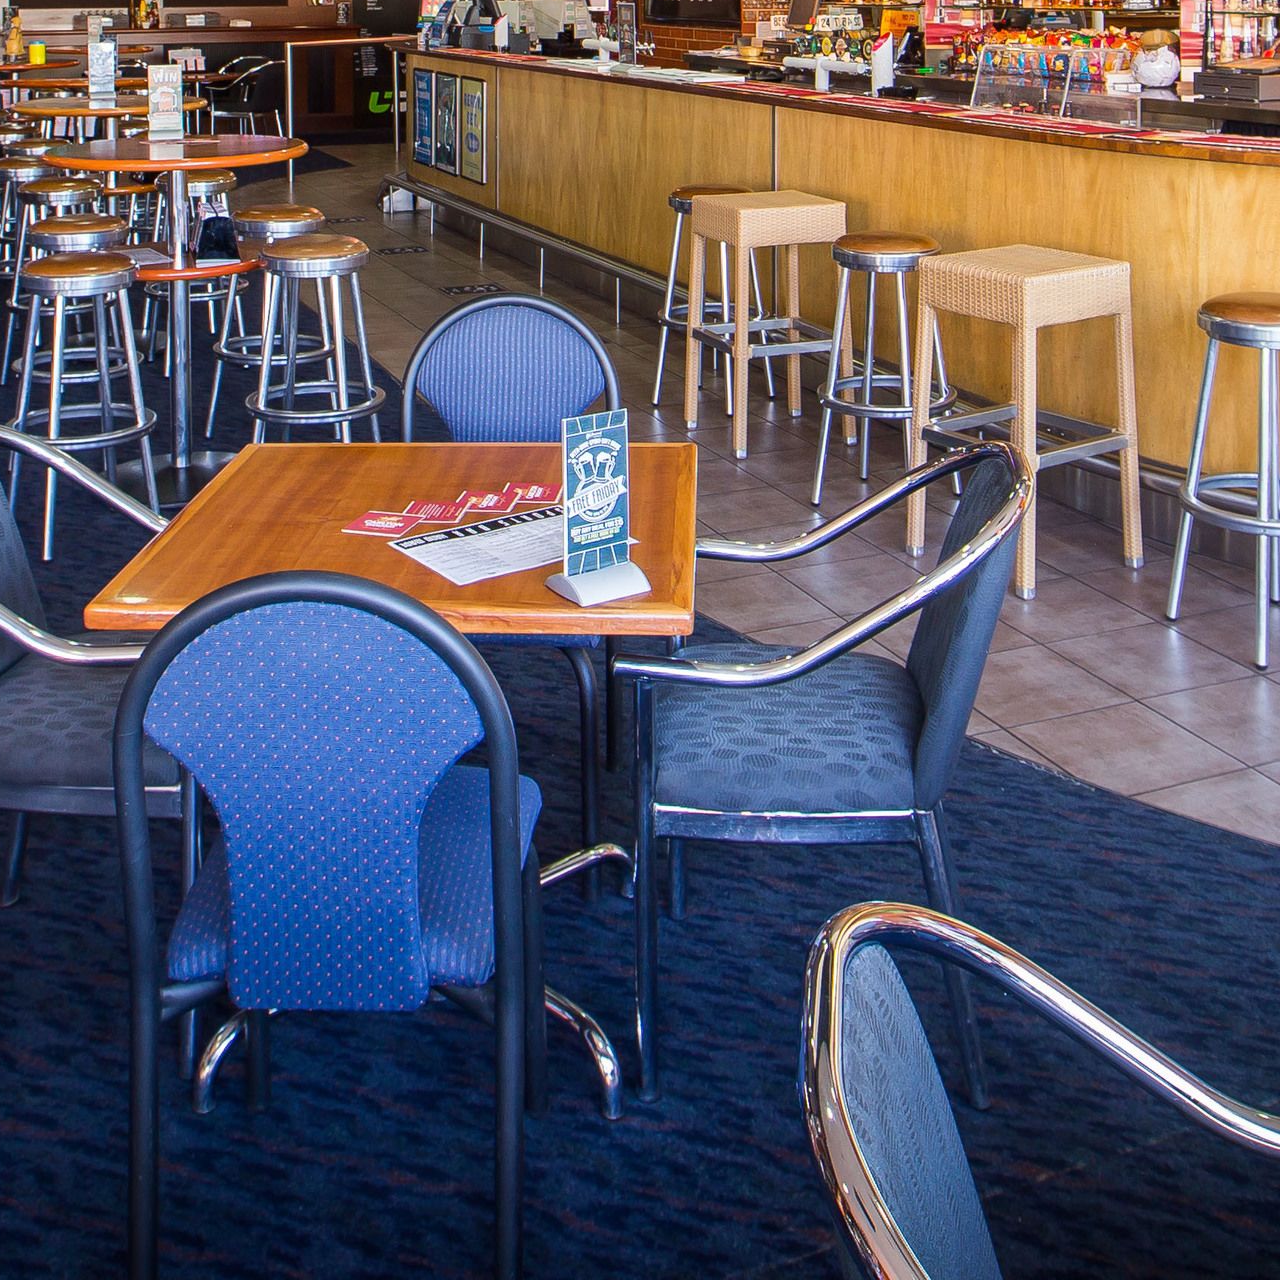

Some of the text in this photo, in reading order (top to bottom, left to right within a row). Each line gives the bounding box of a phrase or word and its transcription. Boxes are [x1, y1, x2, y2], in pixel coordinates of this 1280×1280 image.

[152, 69, 178, 83] WIN
[572, 479, 620, 514] FREE FRIDAY
